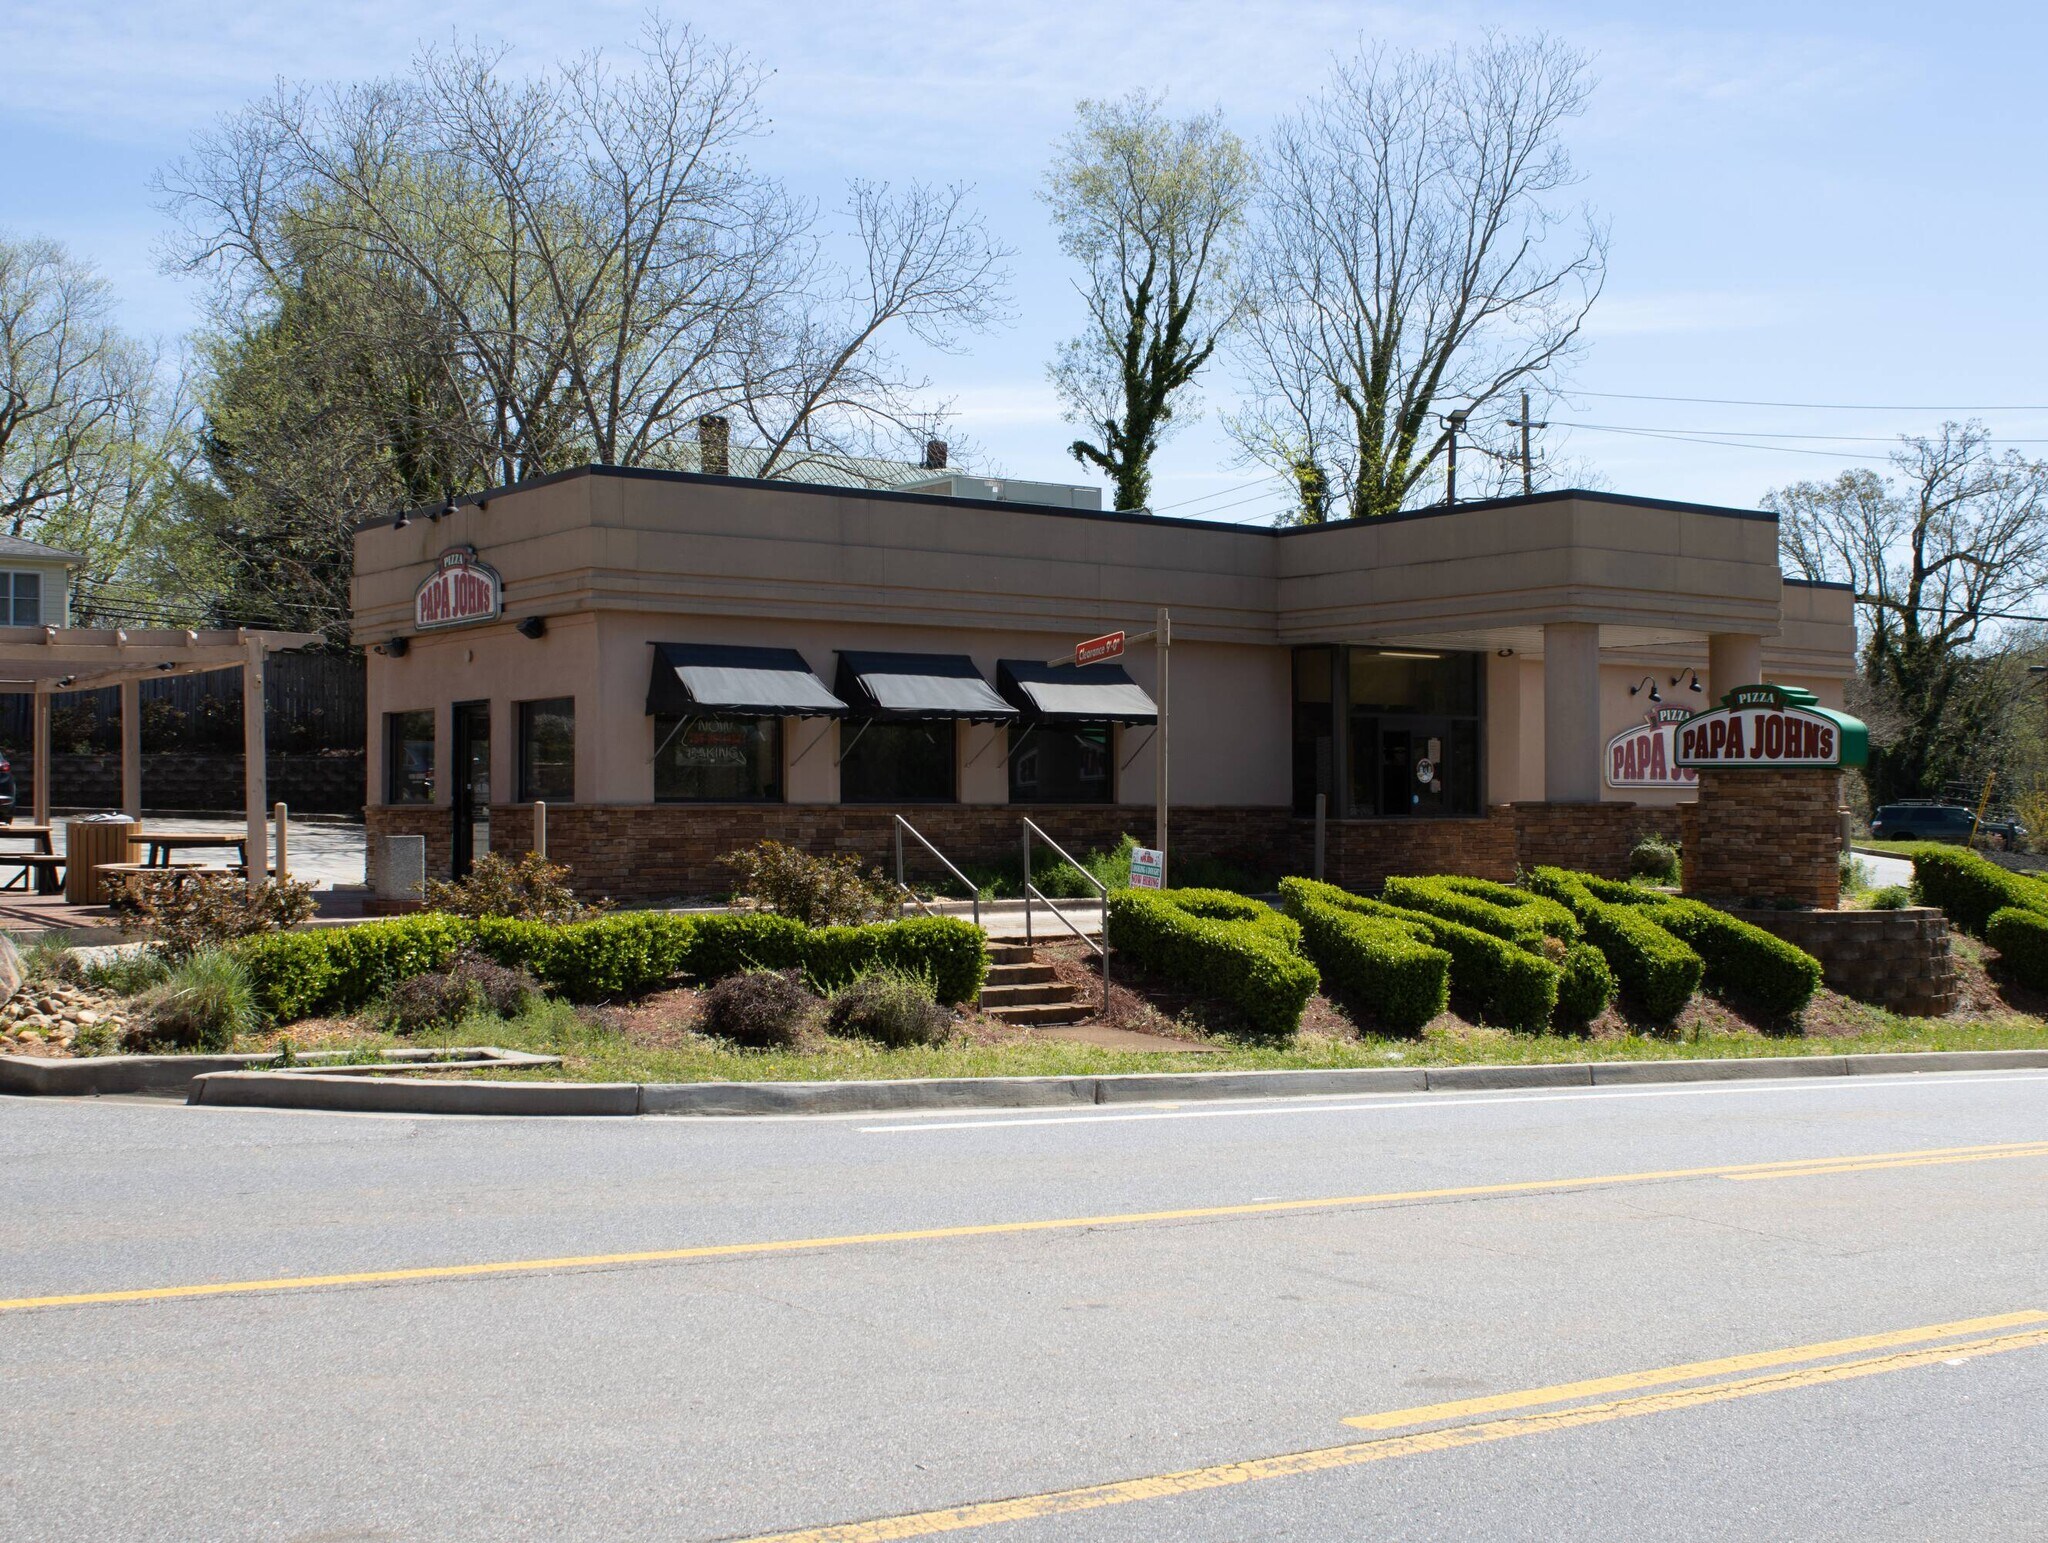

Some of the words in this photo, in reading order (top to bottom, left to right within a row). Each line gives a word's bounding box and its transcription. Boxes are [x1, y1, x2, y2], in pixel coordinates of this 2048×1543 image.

[443, 553, 464, 568] PIZZA
[420, 576, 451, 623] PAPA
[1078, 646, 1105, 661] Clearance
[1738, 692, 1775, 704] PIZZA
[1682, 715, 1745, 759] PAPA
[1750, 714, 1834, 759] JOHN'S
[1613, 732, 1667, 780] PAPA
